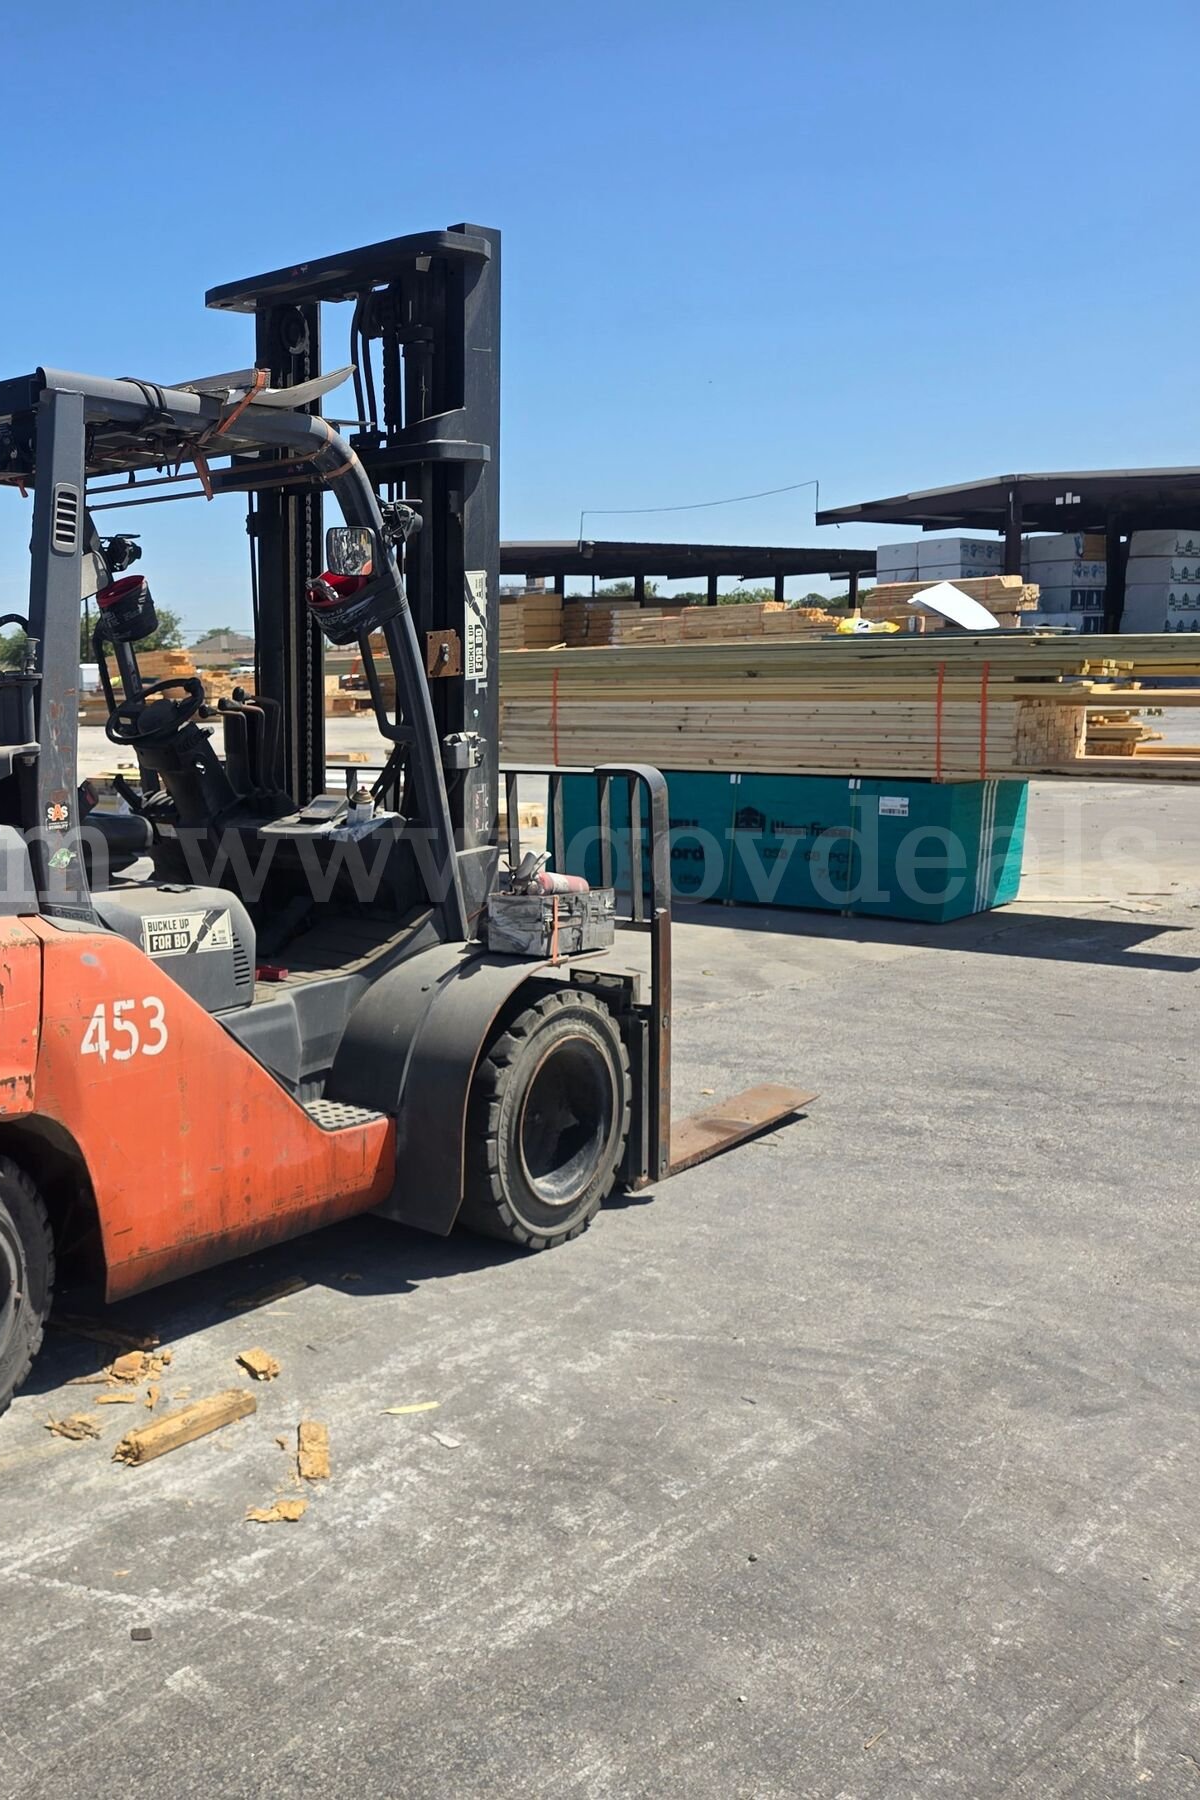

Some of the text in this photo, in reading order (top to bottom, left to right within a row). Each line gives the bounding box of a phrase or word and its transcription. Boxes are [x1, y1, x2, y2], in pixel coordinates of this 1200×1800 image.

[468, 624, 474, 637] UP
[475, 647, 483, 669] FOR
[47, 804, 69, 821] SAS
[147, 918, 190, 933] BUCKLE UP
[152, 932, 188, 951] FOR BO
[80, 995, 169, 1065] 453
